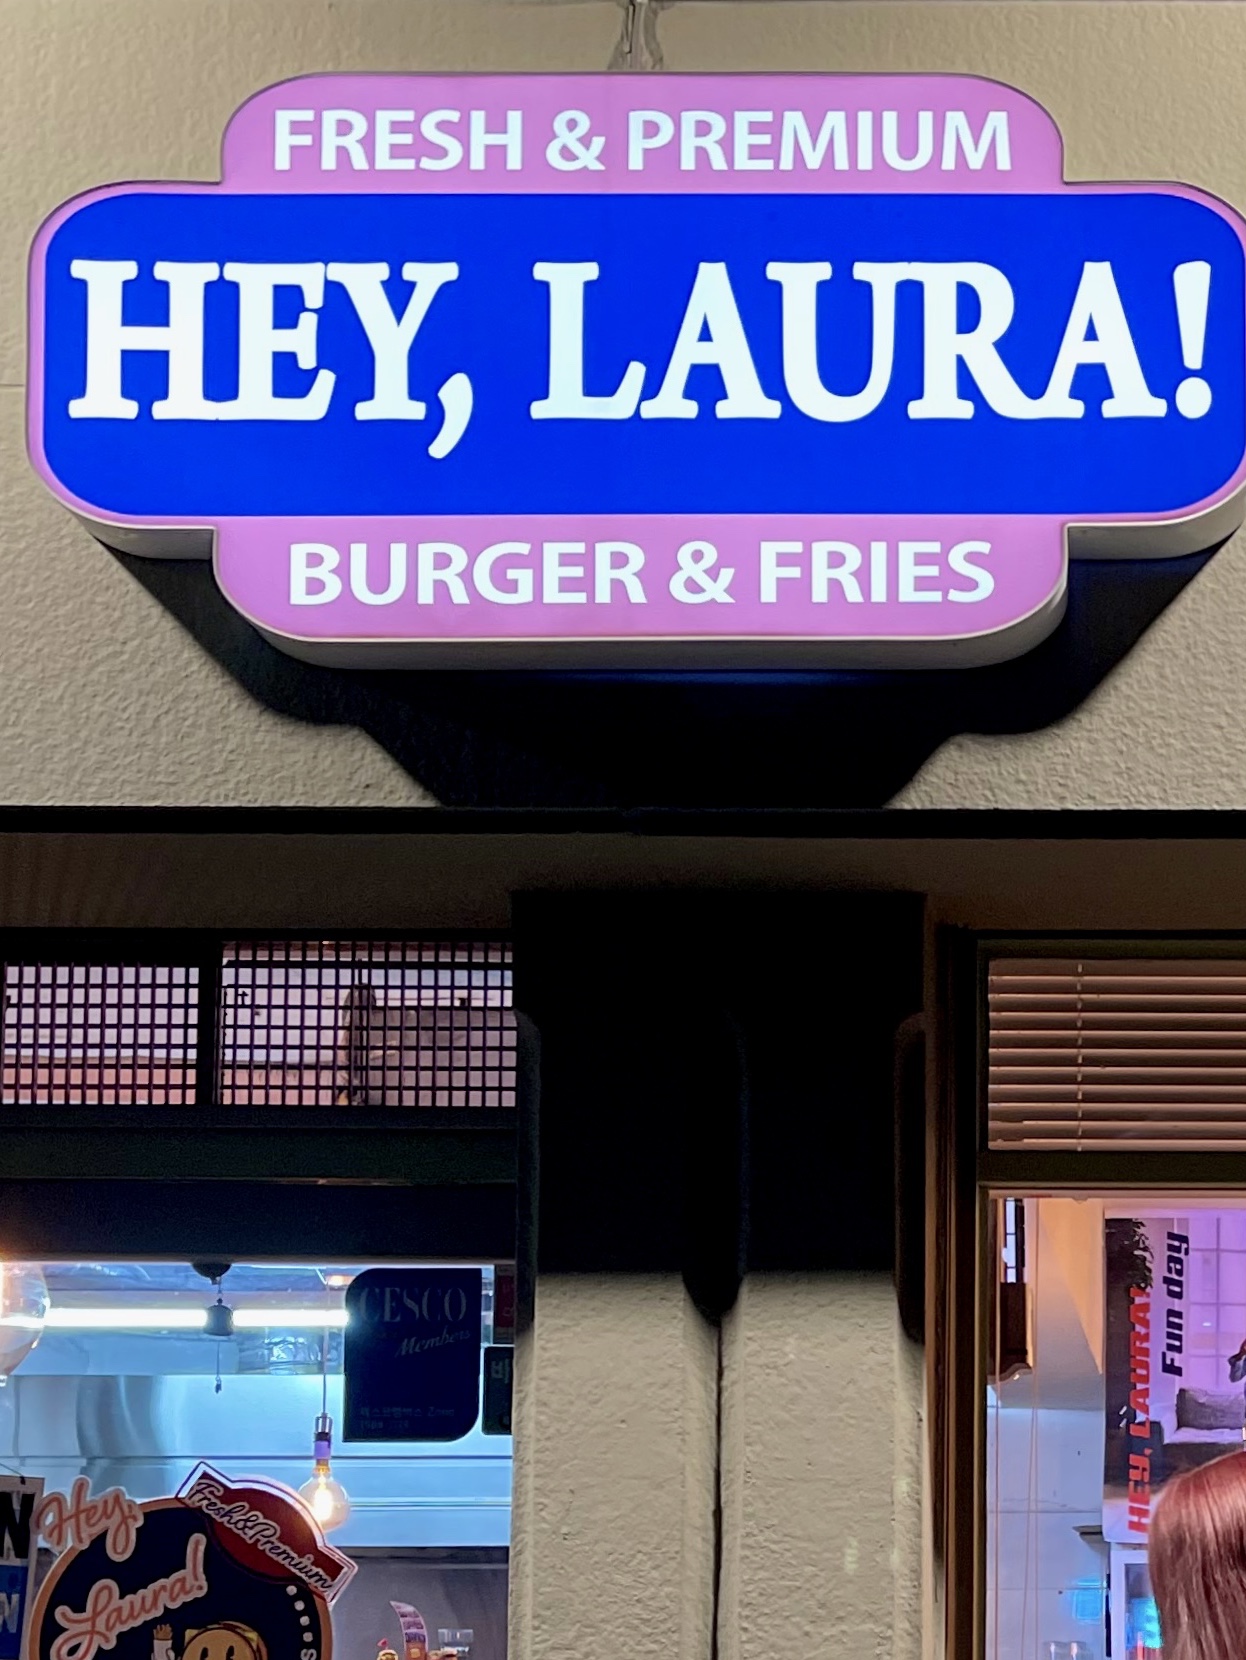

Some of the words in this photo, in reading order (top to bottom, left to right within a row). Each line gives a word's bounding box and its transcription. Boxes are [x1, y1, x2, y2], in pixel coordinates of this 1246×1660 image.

[274, 109, 523, 171] FRESH
[545, 109, 606, 171] &
[628, 110, 1011, 171] PREMIUM
[68, 259, 472, 458] HEY,
[531, 260, 1211, 422] LAURA!
[289, 541, 647, 605] BURGER
[668, 540, 735, 604] &
[760, 540, 994, 603] FRIES
[1162, 1231, 1190, 1300] day
[1128, 1287, 1152, 1439] LAURA!
[1161, 1308, 1183, 1377] Fun
[1128, 1447, 1153, 1534] HEY,
